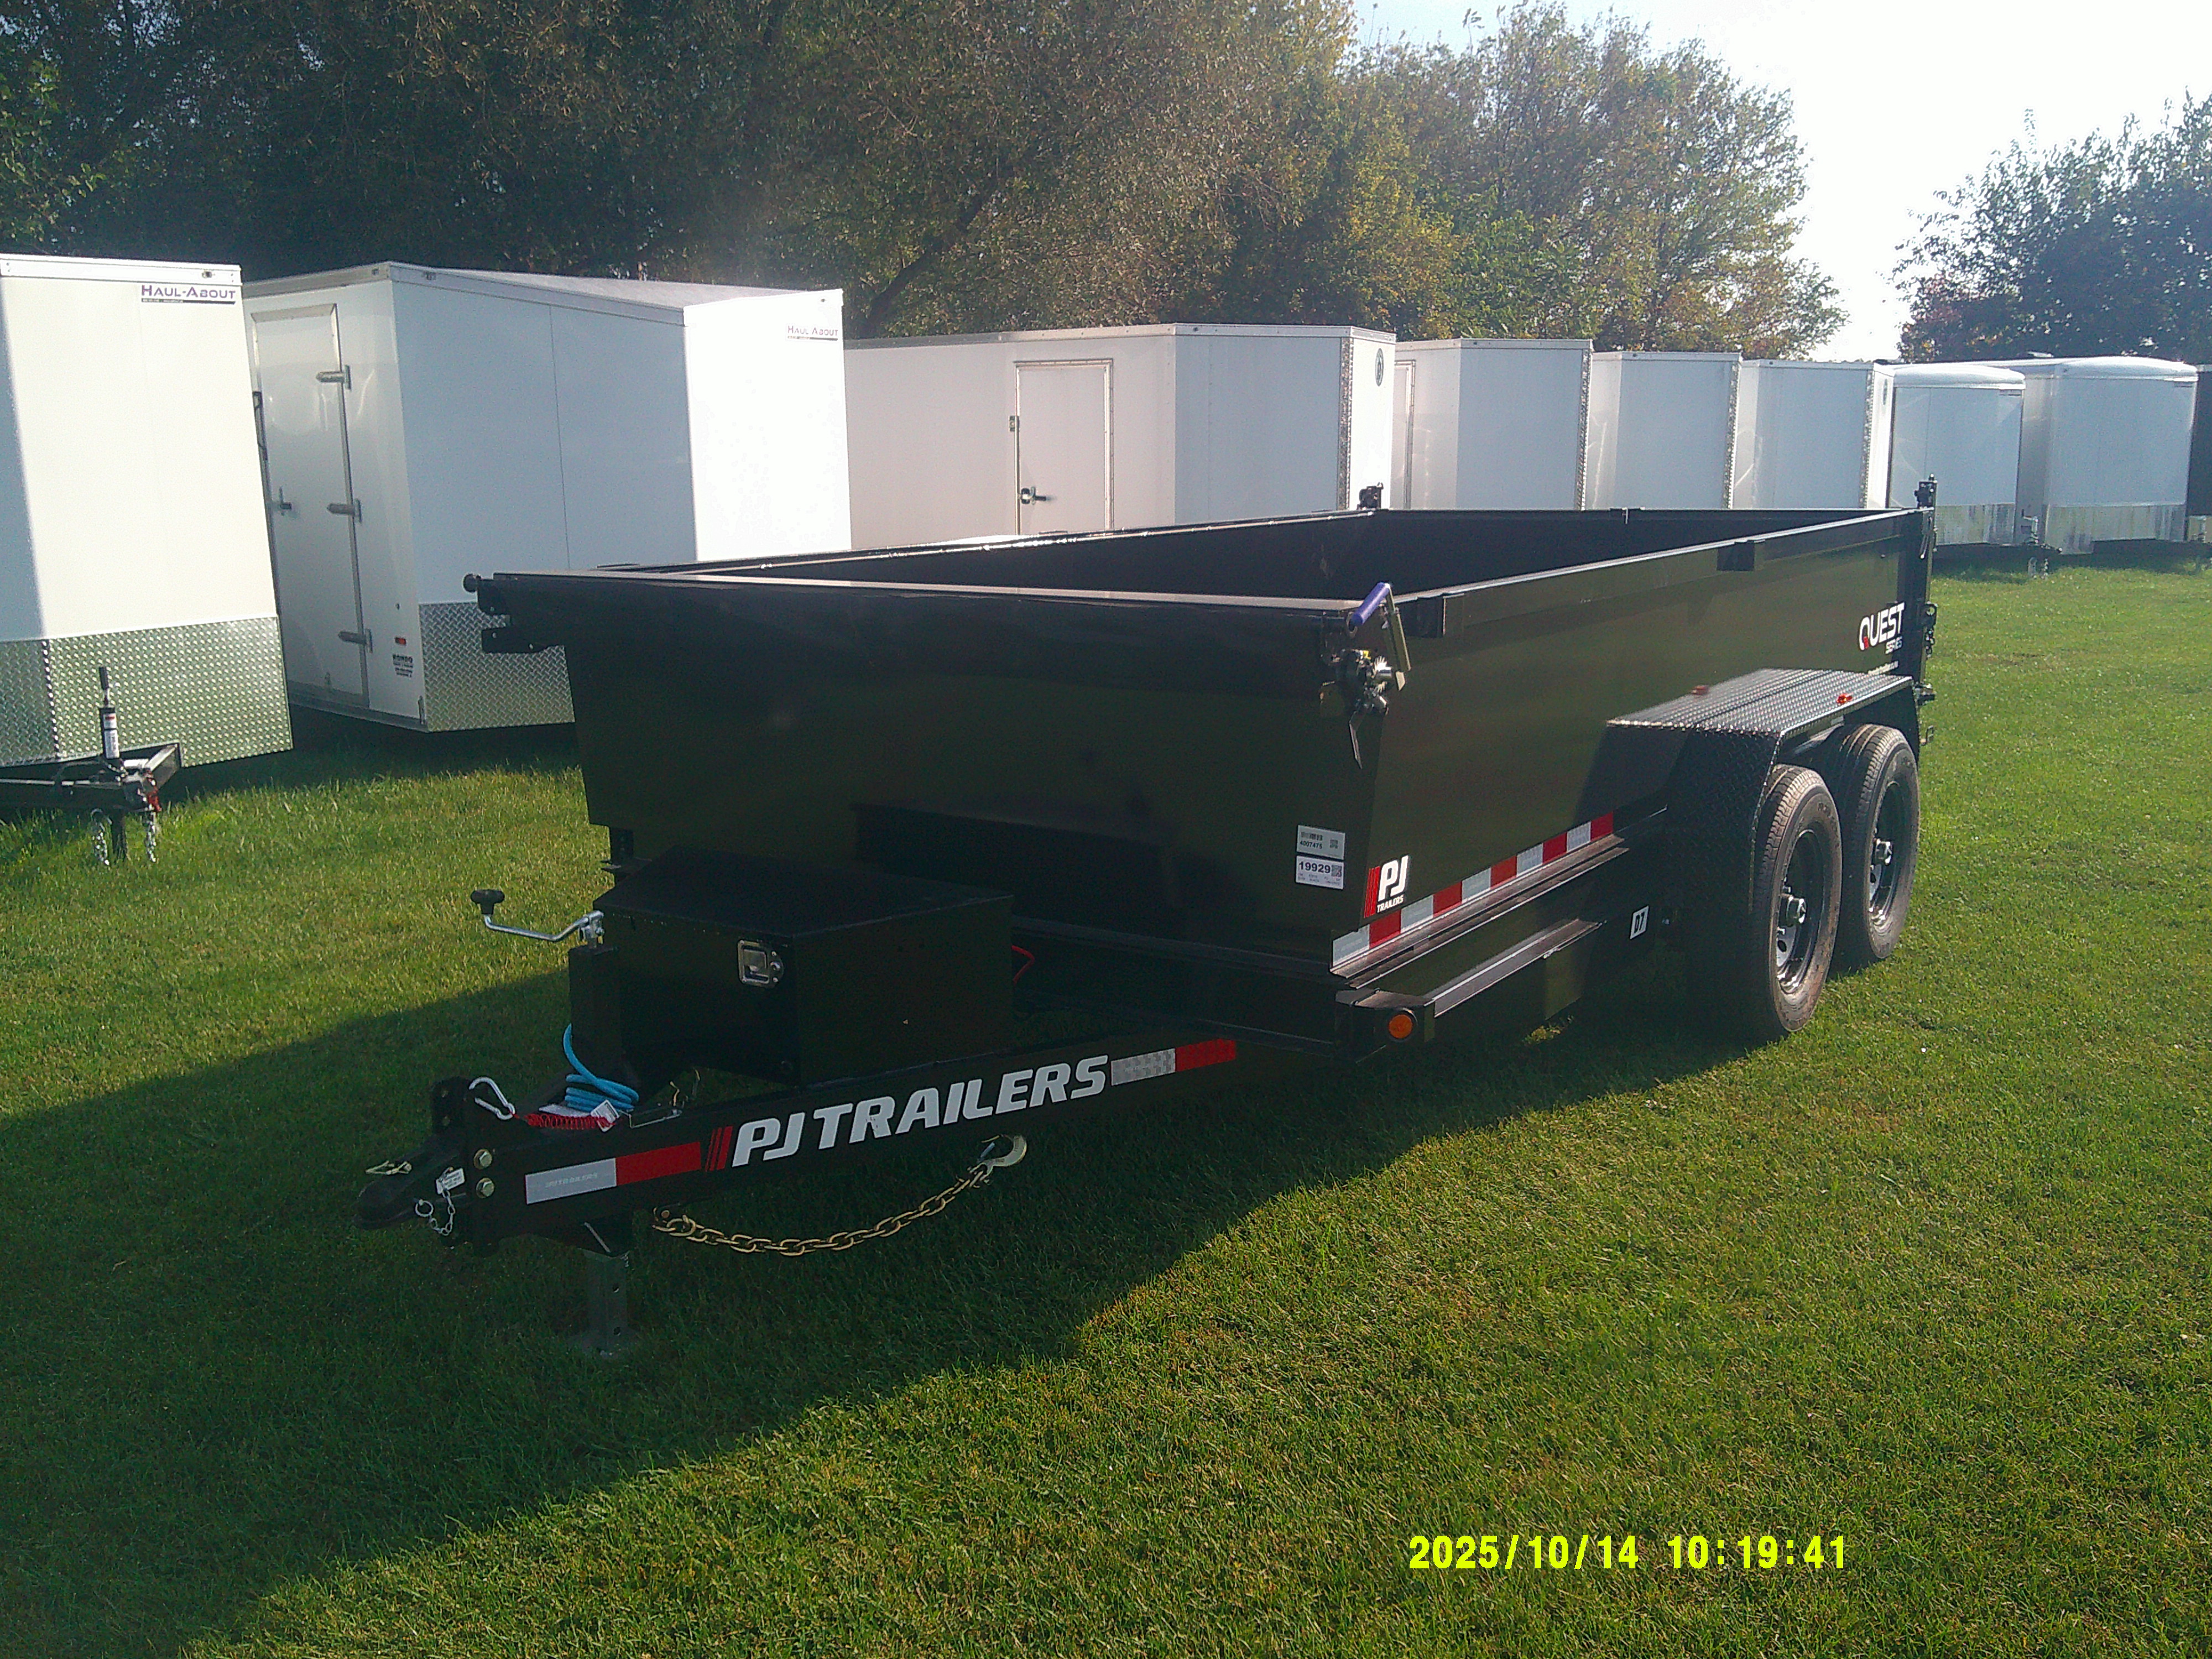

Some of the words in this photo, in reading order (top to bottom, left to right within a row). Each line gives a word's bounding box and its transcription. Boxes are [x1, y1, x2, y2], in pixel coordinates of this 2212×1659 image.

[142, 284, 236, 299] HAUL-ABOUT
[787, 325, 808, 335] HAUL
[812, 327, 838, 336] ABOUT
[1859, 602, 1905, 650] QUEST
[1299, 862, 1331, 874] 19929
[1378, 855, 1408, 902] PJ
[1377, 894, 1404, 914] TRAILERS
[813, 1054, 1109, 1150] TRAILERS
